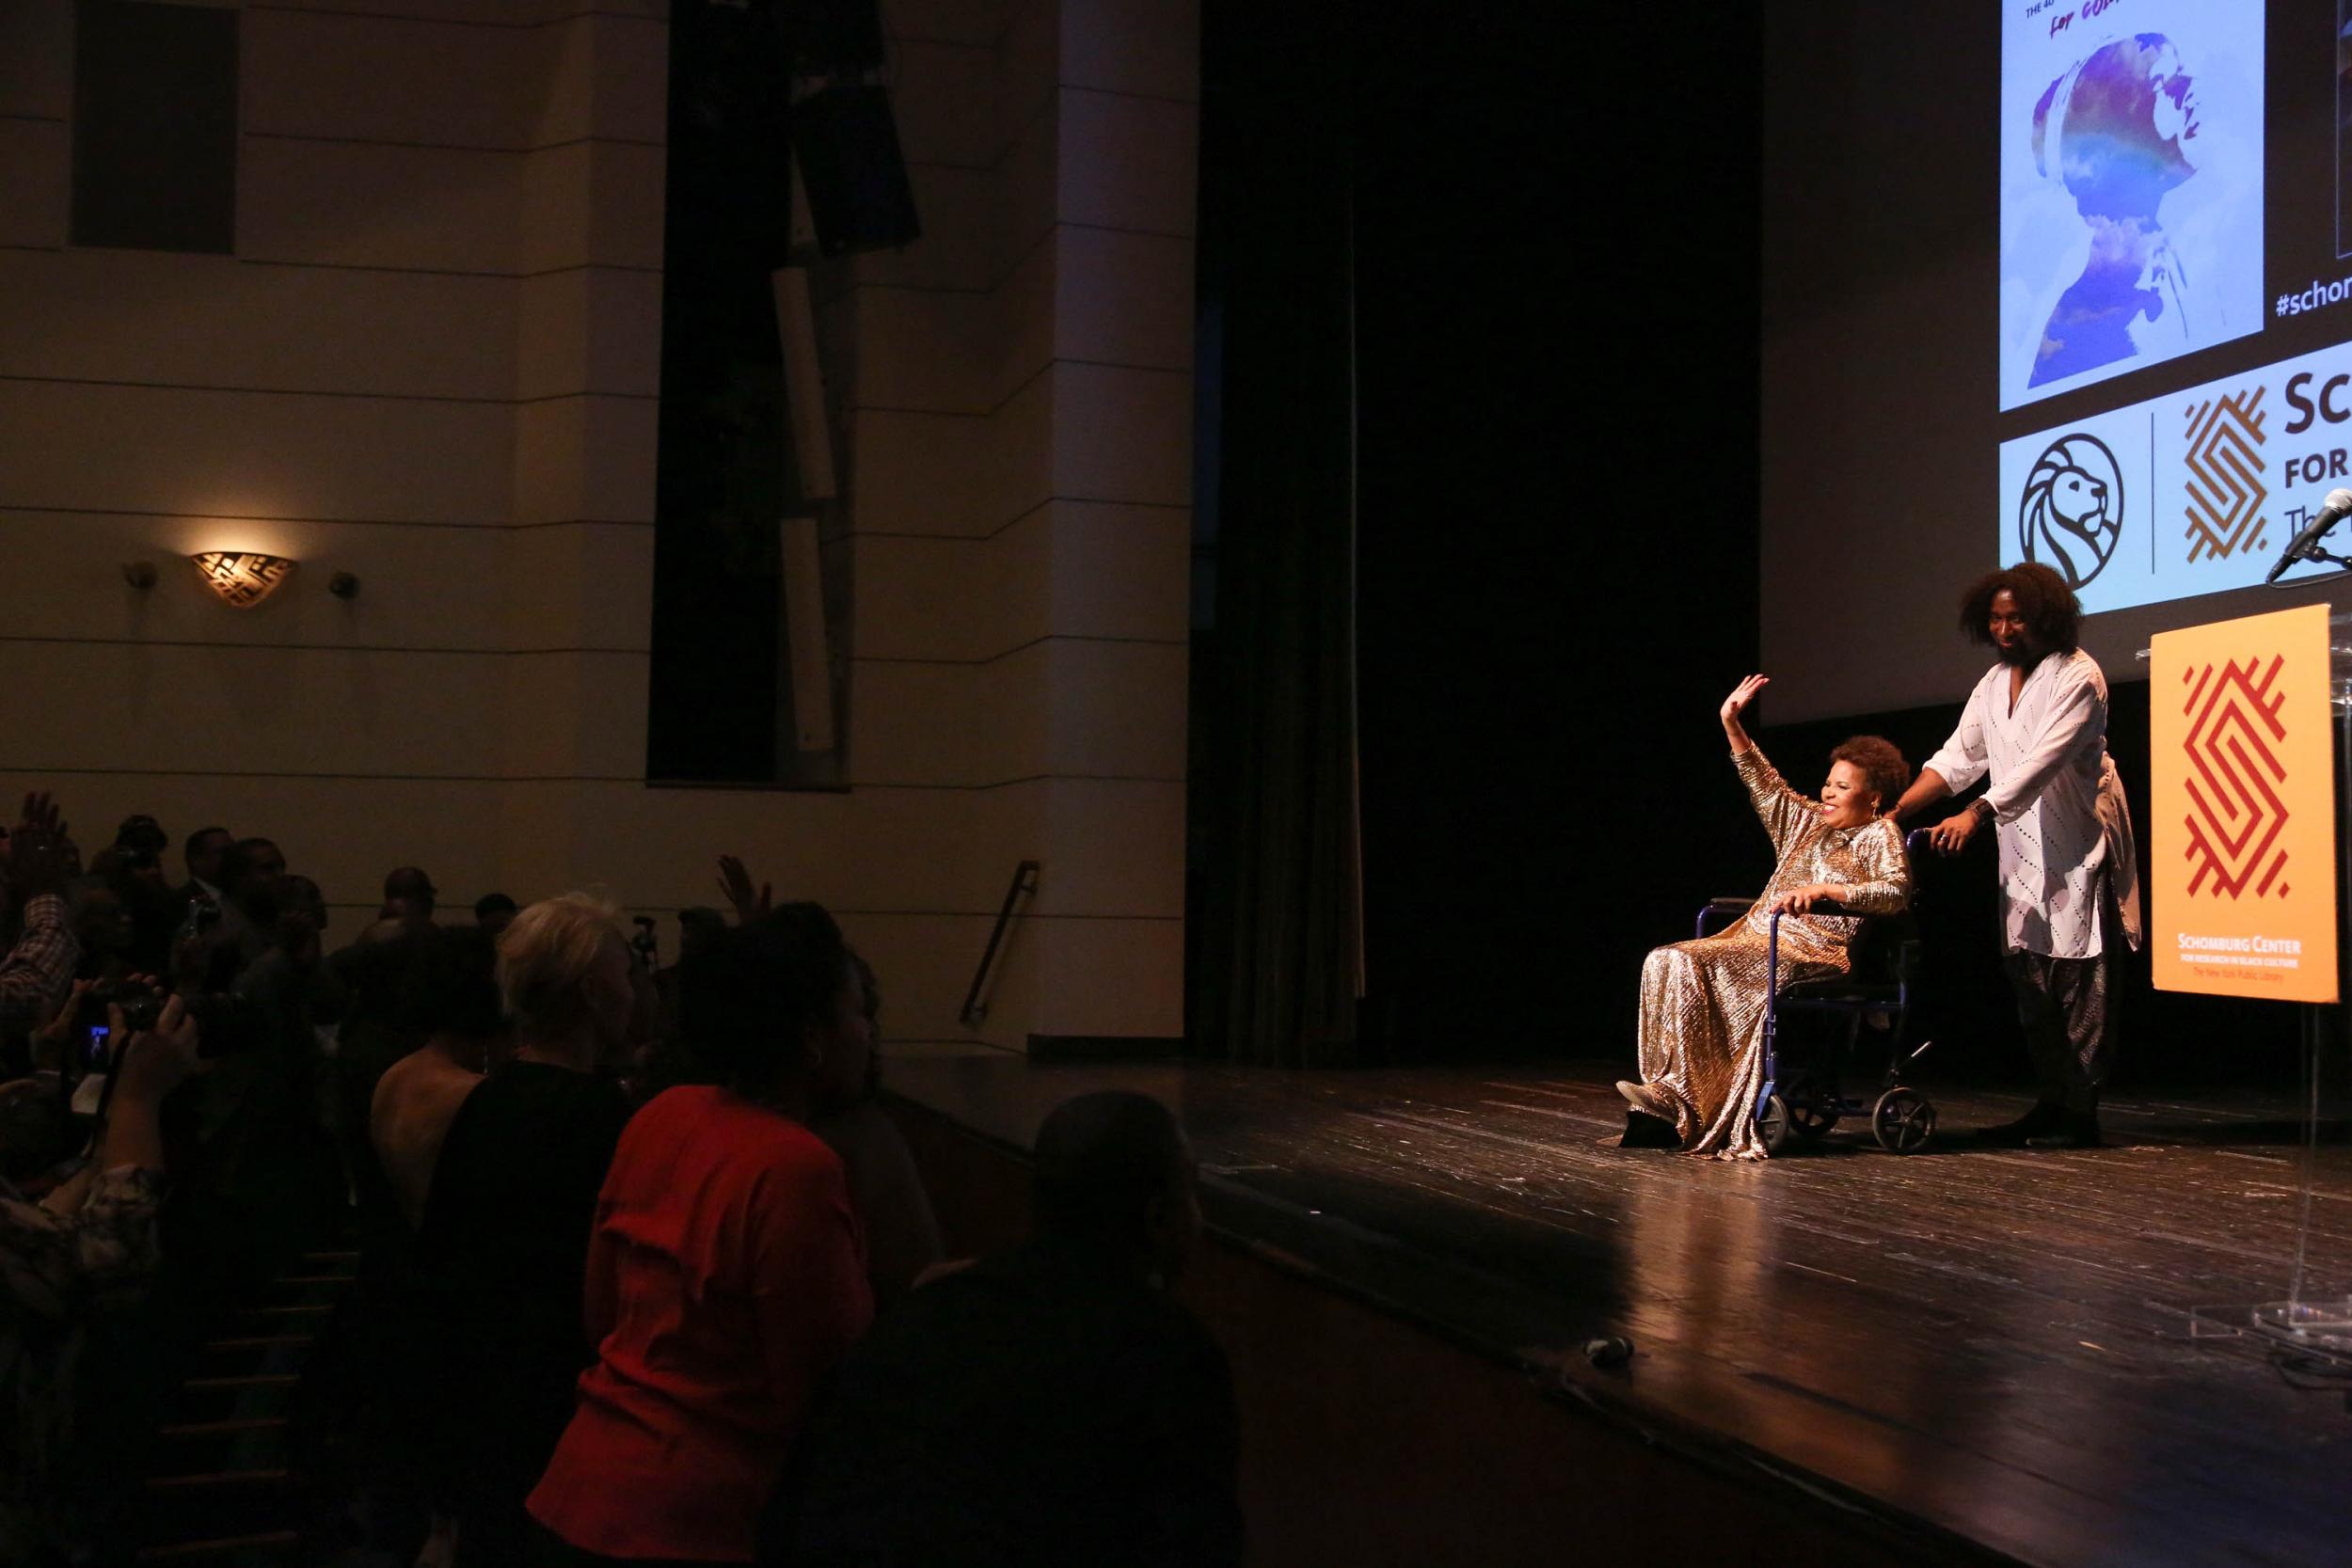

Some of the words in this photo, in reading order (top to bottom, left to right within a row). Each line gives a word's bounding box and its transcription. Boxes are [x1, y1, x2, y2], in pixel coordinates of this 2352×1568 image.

[2026, 3, 2042, 19] THE
[2285, 448, 2348, 488] FOR
[2284, 504, 2336, 541] Th
[2178, 933, 2249, 952] SCHOMBURG
[2252, 935, 2301, 955] CENTER
